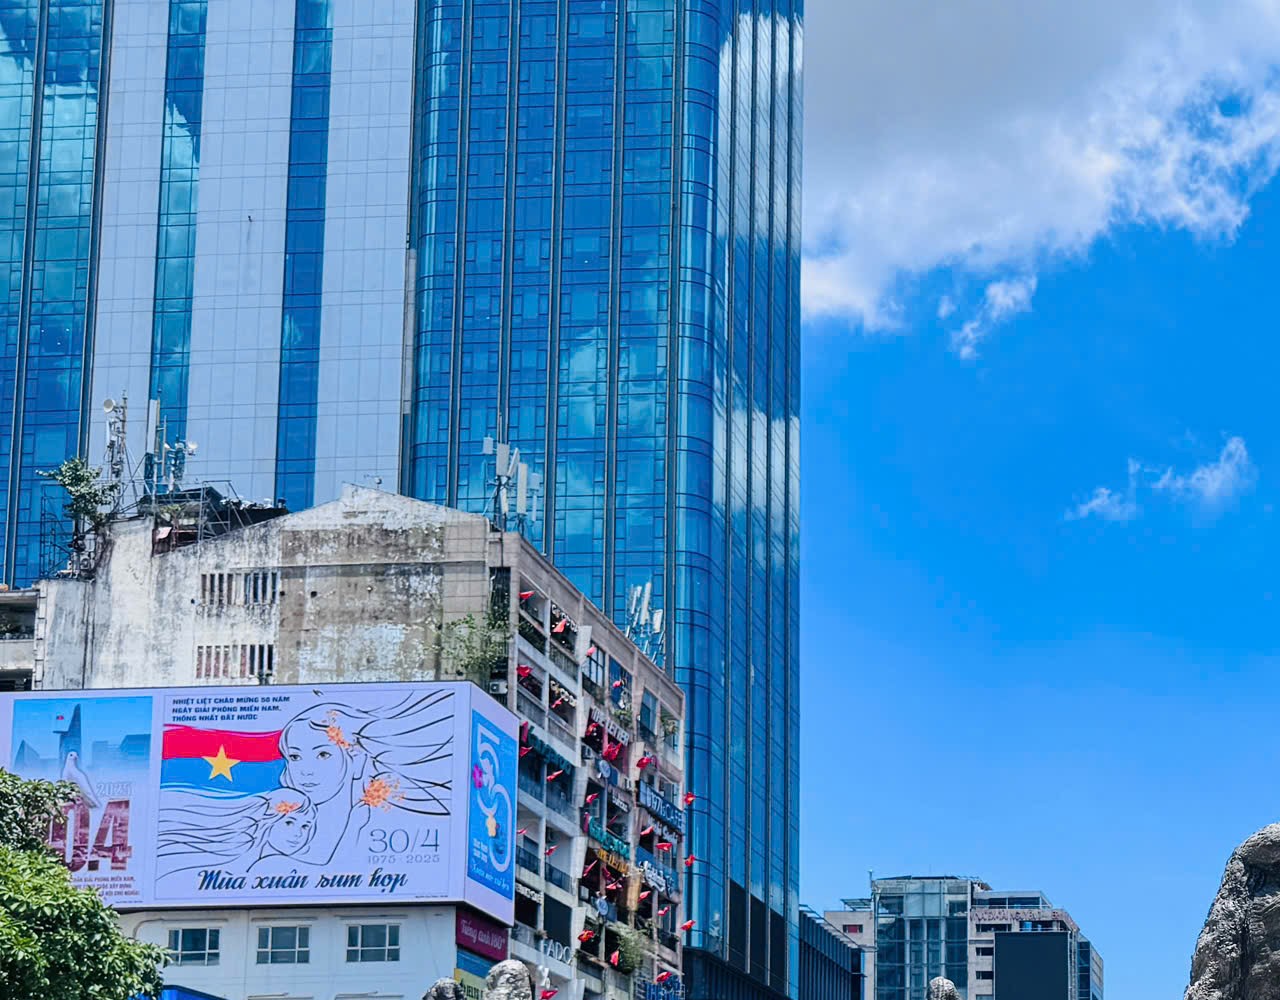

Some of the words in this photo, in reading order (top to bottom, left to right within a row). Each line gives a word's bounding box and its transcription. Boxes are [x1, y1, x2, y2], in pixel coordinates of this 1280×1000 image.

[368, 828, 440, 854] 30/4
[368, 855, 396, 864] 1975
[406, 854, 440, 864] 2025
[198, 869, 247, 891] Mùa
[251, 869, 309, 890] xuân
[315, 872, 363, 889] sum
[368, 867, 408, 892] họp
